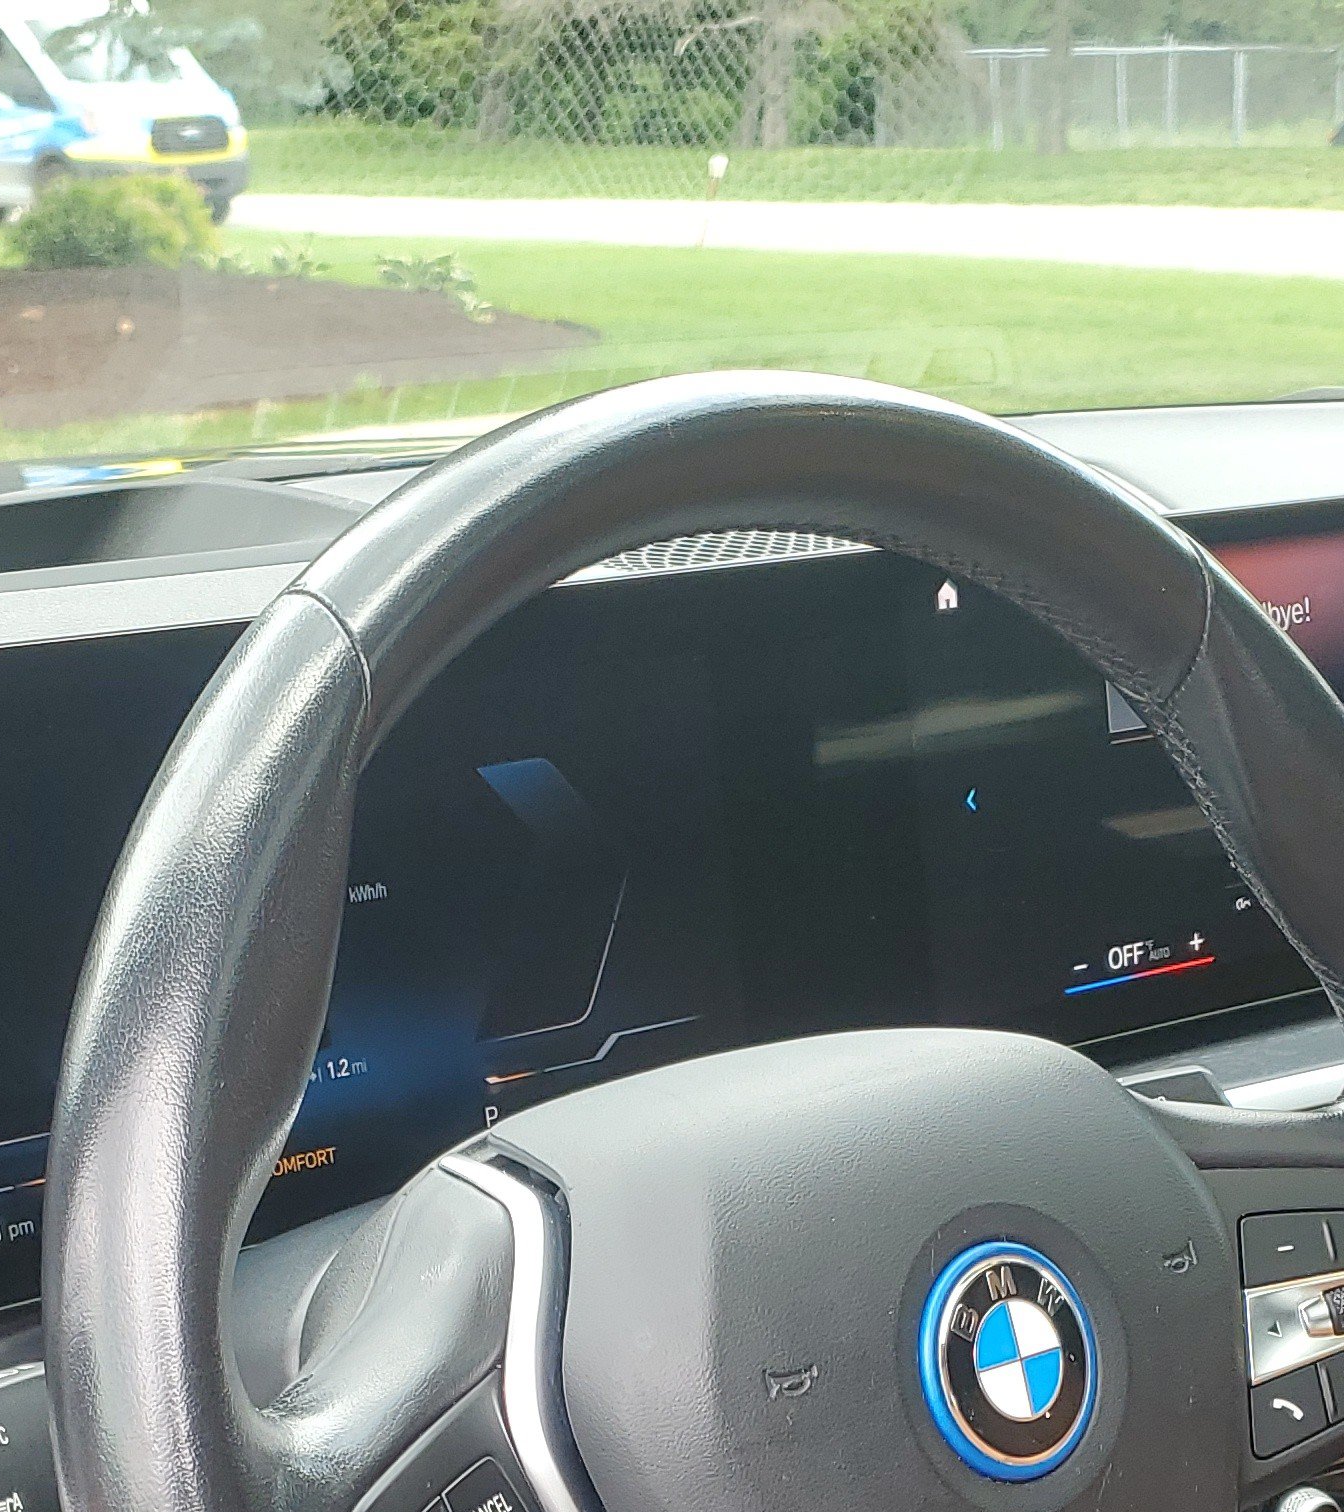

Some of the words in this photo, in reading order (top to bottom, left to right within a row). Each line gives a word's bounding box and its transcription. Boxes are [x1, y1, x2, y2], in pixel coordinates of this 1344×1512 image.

[1263, 596, 1311, 631] bye!
[1108, 941, 1145, 969] OFF
[327, 1058, 350, 1079] 1.2
[351, 1058, 368, 1075] mi
[485, 1106, 499, 1128] P
[272, 1147, 337, 1177] OMFORT
[8, 1219, 35, 1241] pm
